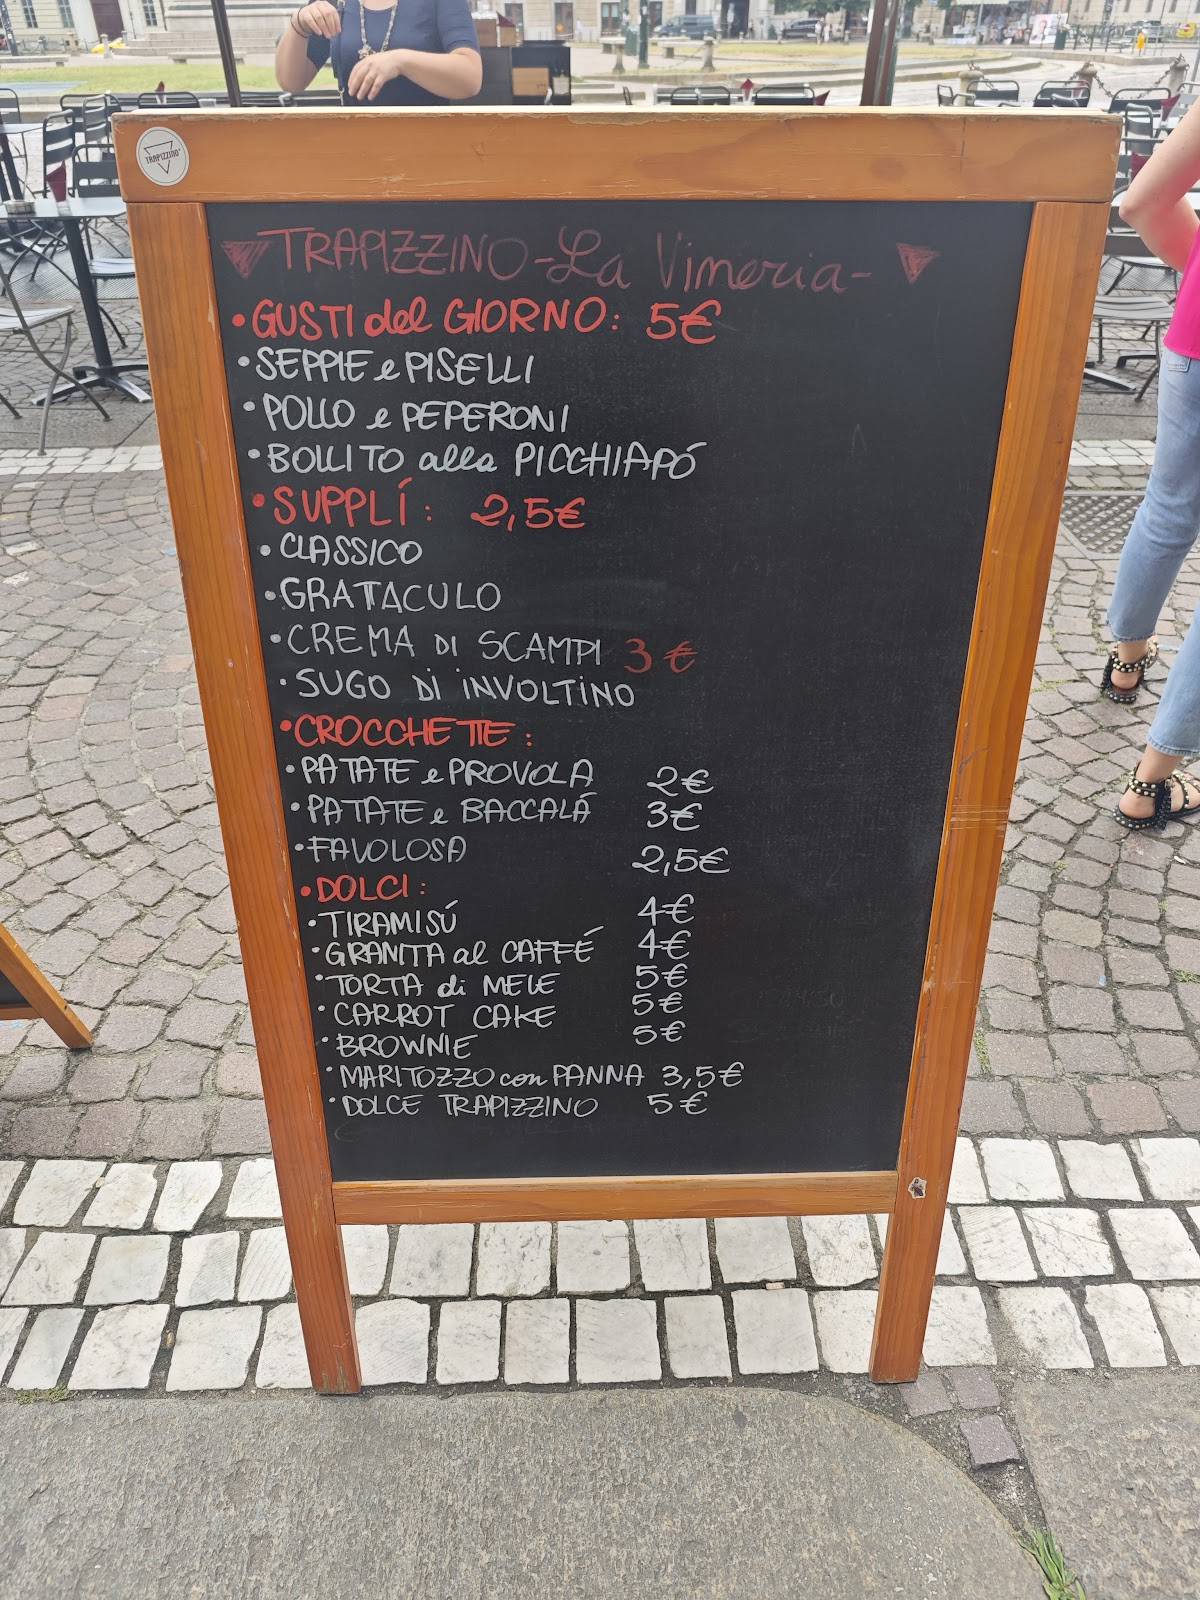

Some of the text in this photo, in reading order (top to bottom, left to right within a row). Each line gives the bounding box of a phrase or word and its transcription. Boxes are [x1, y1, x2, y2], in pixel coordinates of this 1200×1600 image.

[251, 296, 723, 345] GUSTI del GIORNO: 5€
[255, 345, 535, 386] SEPPIE e PISELLI
[262, 392, 570, 433] POLLO e PEPERONI
[266, 442, 405, 474] BOLLITO
[418, 443, 498, 473] alla
[469, 493, 587, 533] 2,5€
[279, 531, 423, 567] CLASSICO
[286, 623, 416, 659] CREMA
[433, 633, 458, 657] DI
[477, 629, 601, 666] SCAMPI
[295, 667, 391, 701] SUGO
[300, 753, 594, 789] PATATE e PROVOLA
[646, 765, 715, 798] 2€
[306, 793, 427, 826] PATATE
[432, 807, 456, 825] e
[645, 800, 704, 832] 3€
[306, 835, 468, 864] FAVOLOSA
[631, 844, 732, 877] 2,5€
[636, 893, 696, 927] 4€
[324, 940, 446, 968] GRANITA
[452, 939, 489, 966] al
[637, 927, 692, 961] 4€
[325, 971, 562, 998] TORTA di MELE
[635, 962, 690, 991] 5€
[333, 1001, 558, 1030] CARROT CAKE
[631, 991, 684, 1017] 5€
[335, 1031, 480, 1060] BROWNIE
[631, 1020, 687, 1046] 5€
[339, 1060, 746, 1090] MARITOZZO con PANNA 3,5€
[341, 1092, 600, 1119] DOLCE TRAPIZZINO
[646, 1090, 709, 1116] 5€
